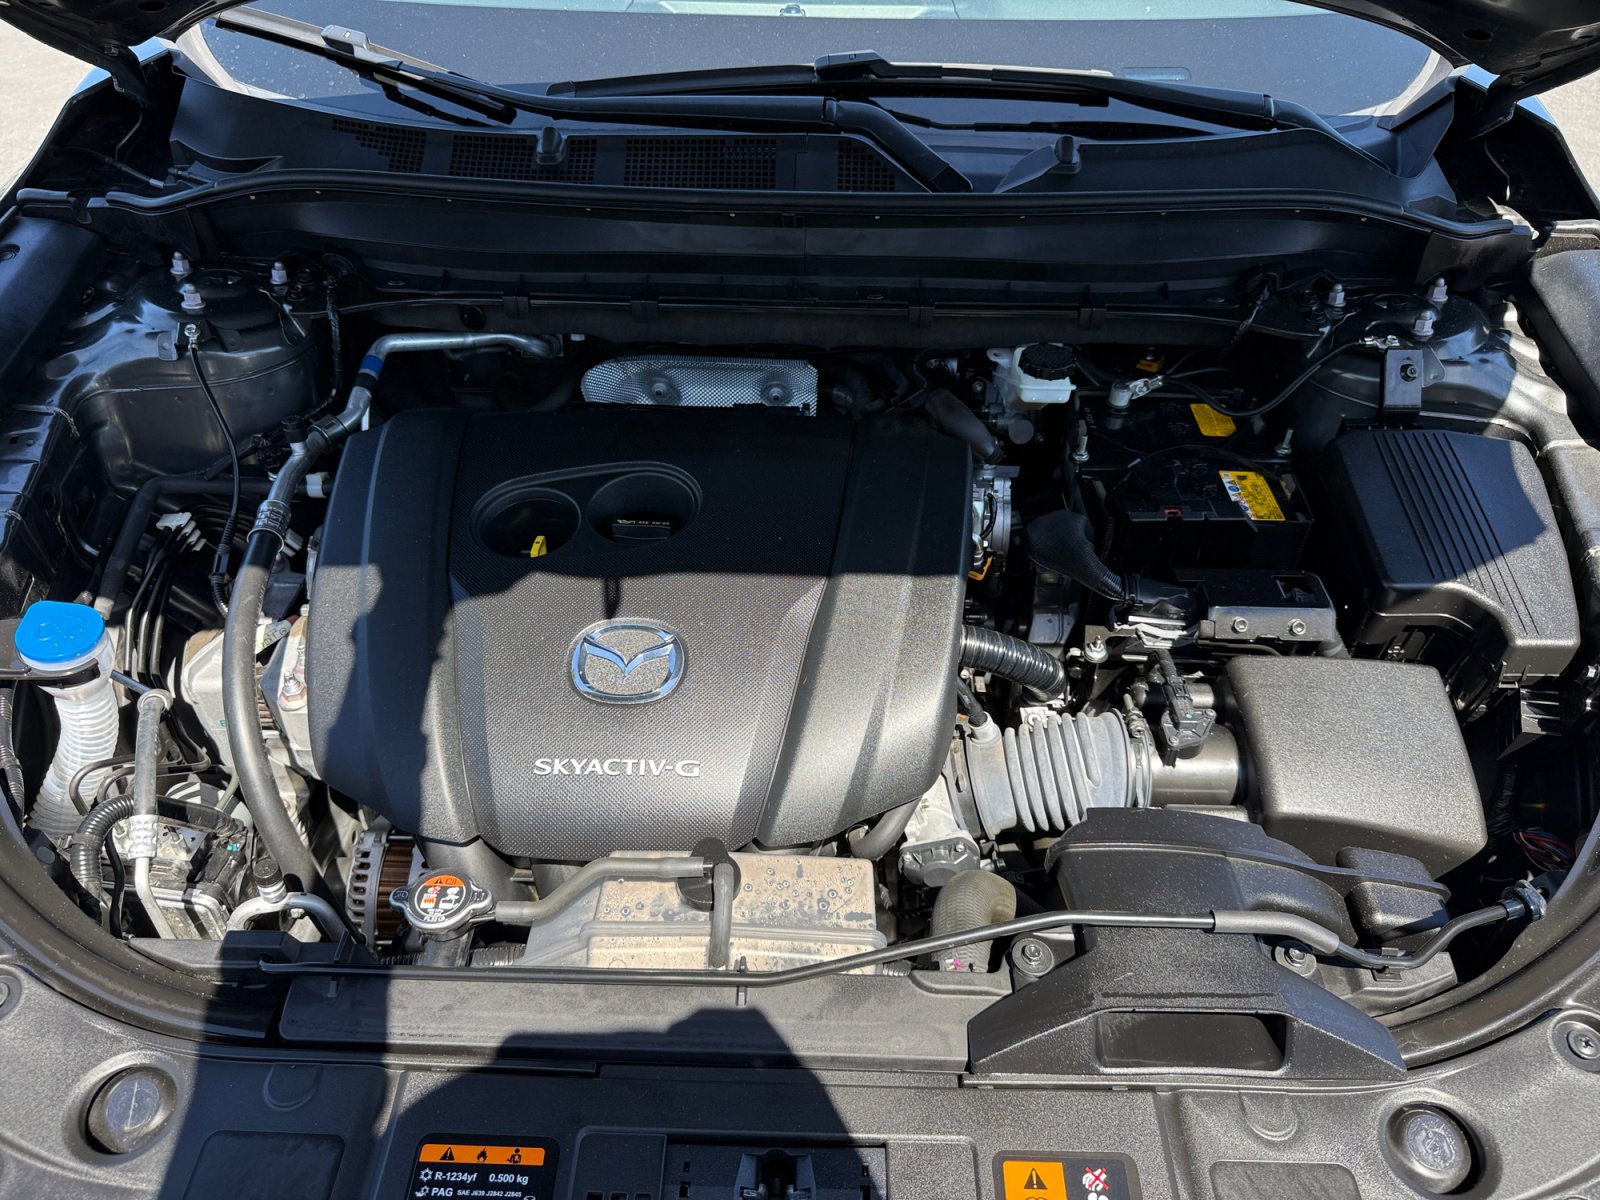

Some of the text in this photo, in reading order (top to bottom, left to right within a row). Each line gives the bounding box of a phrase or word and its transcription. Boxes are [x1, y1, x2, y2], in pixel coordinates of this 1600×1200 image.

[534, 758, 701, 777] SKYACTIV-G
[434, 1172, 529, 1185] R-1234yf 0.500 kg
[431, 1187, 453, 1197] PAG
